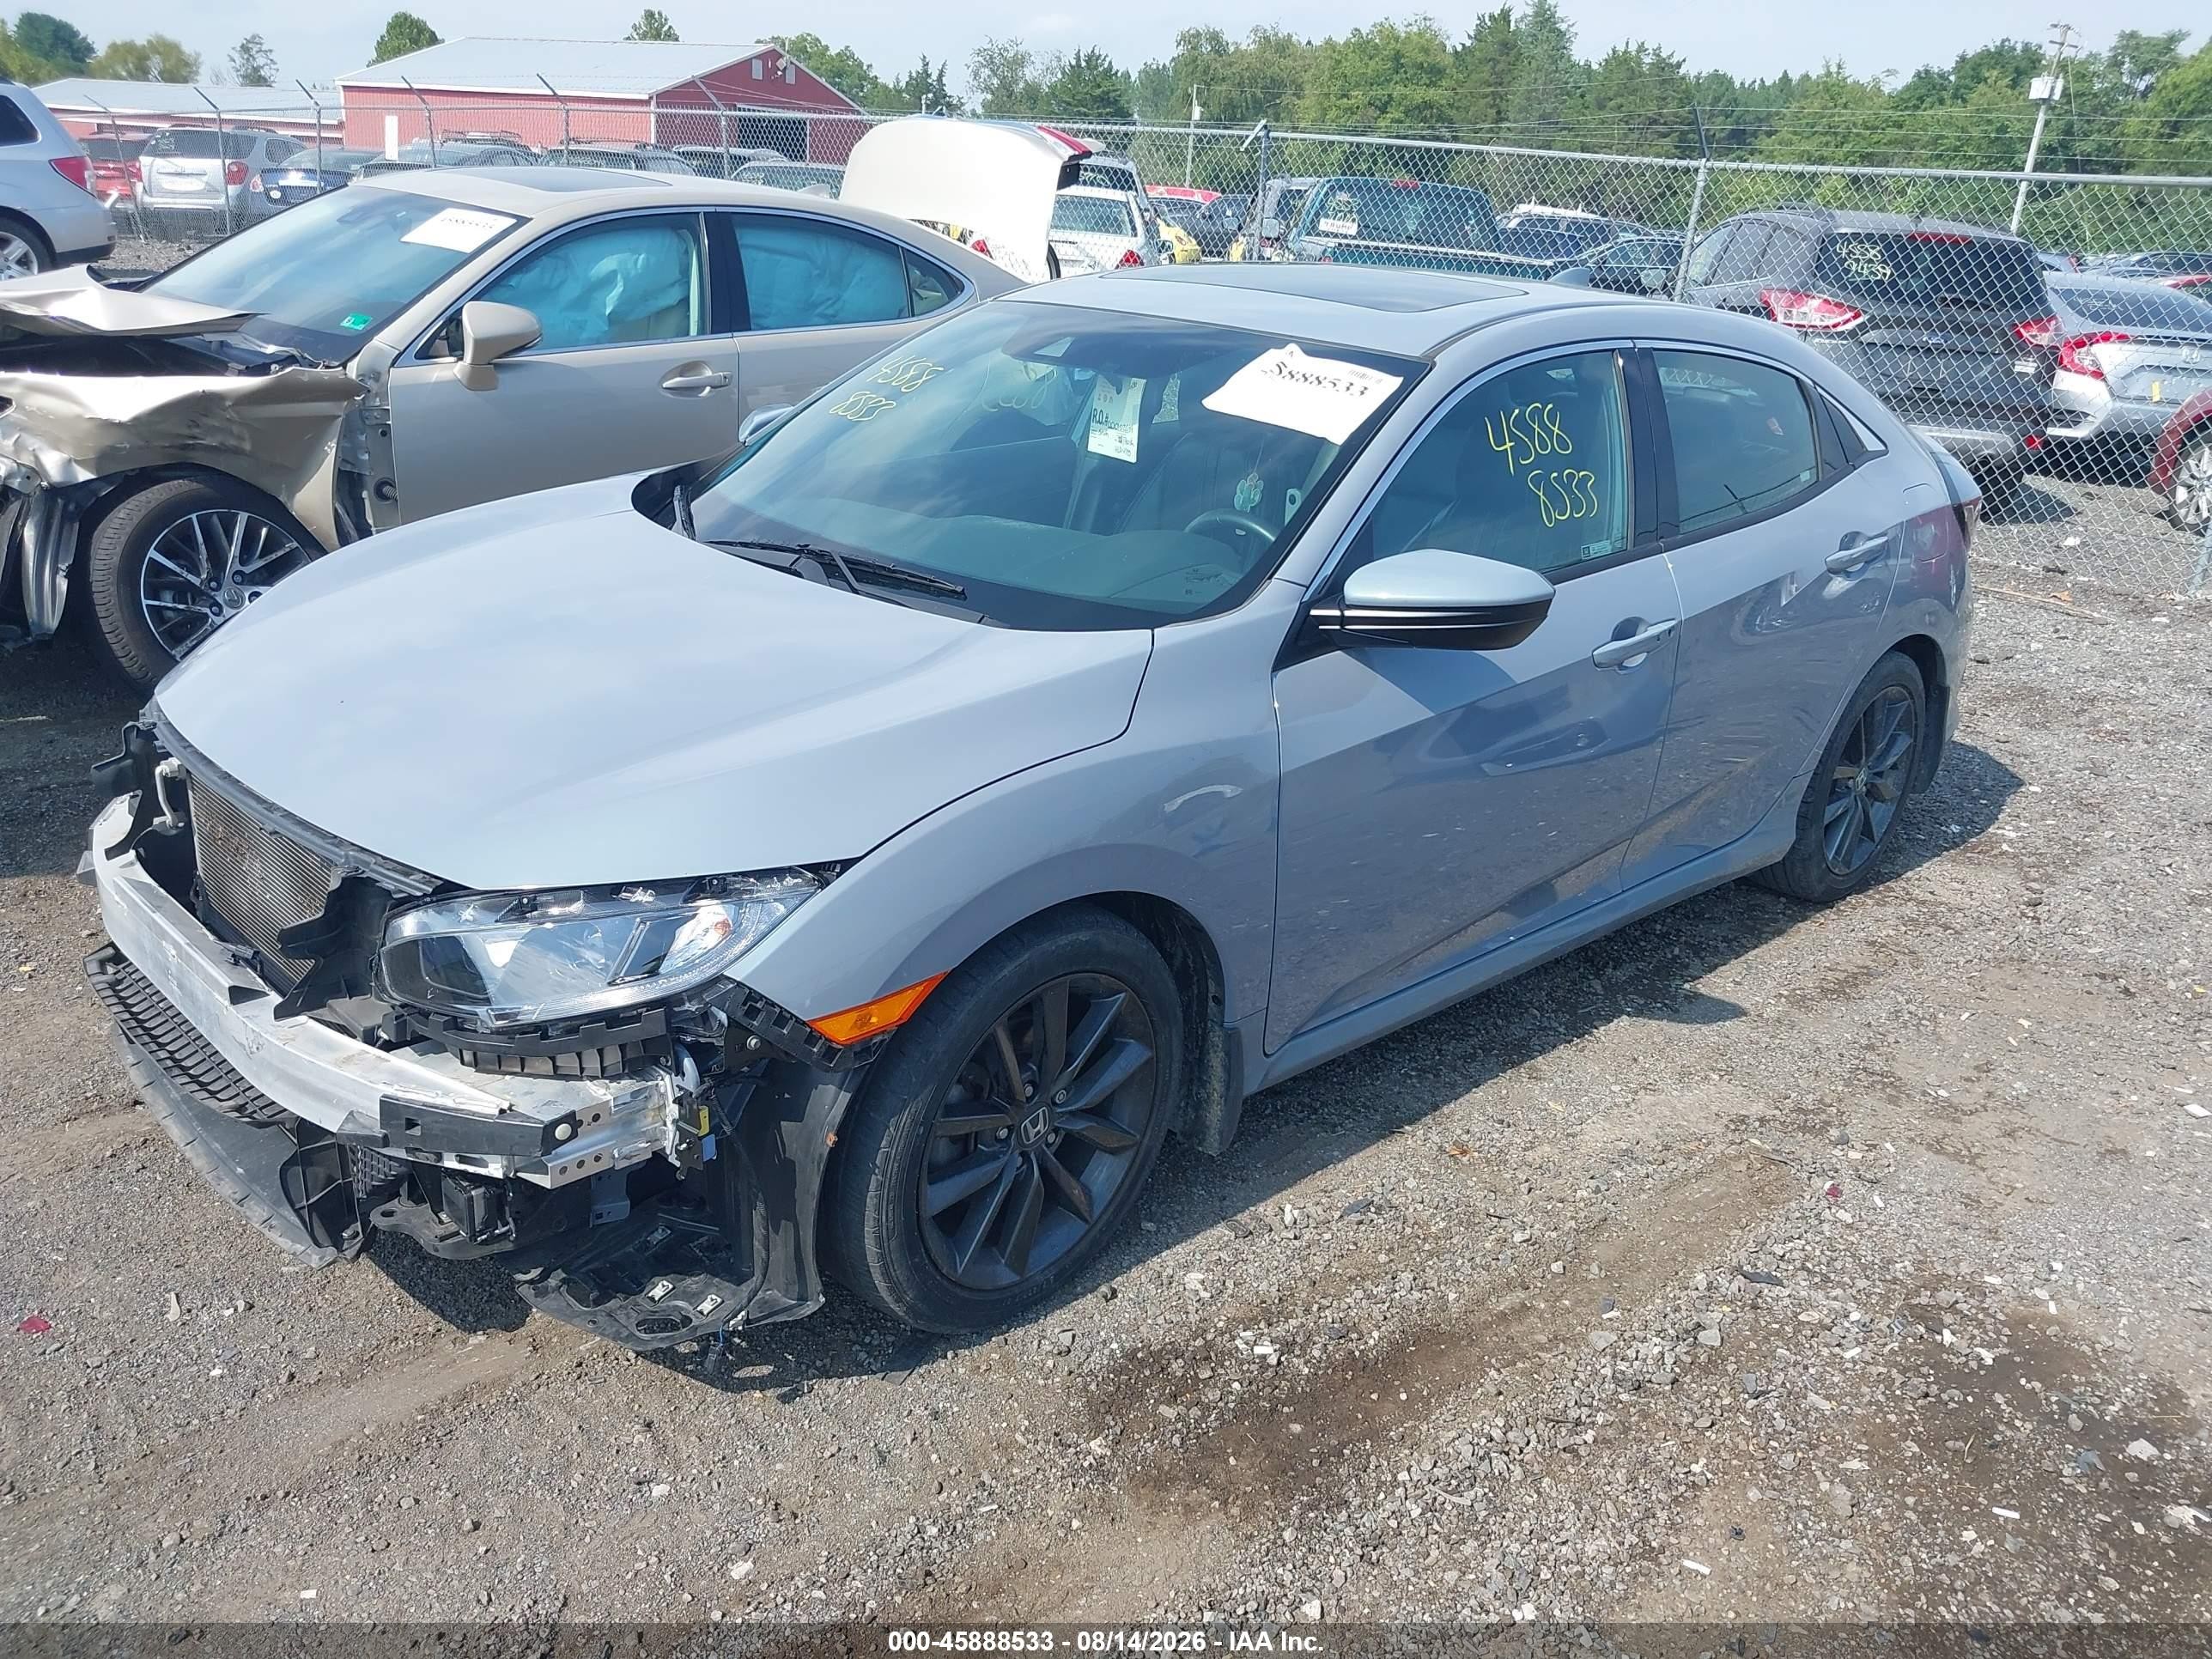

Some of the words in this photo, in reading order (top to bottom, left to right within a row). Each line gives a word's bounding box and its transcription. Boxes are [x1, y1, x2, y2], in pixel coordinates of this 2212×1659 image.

[866, 355, 945, 392] 4588
[1484, 402, 1573, 477] 4588
[1527, 468, 1598, 528] 8533
